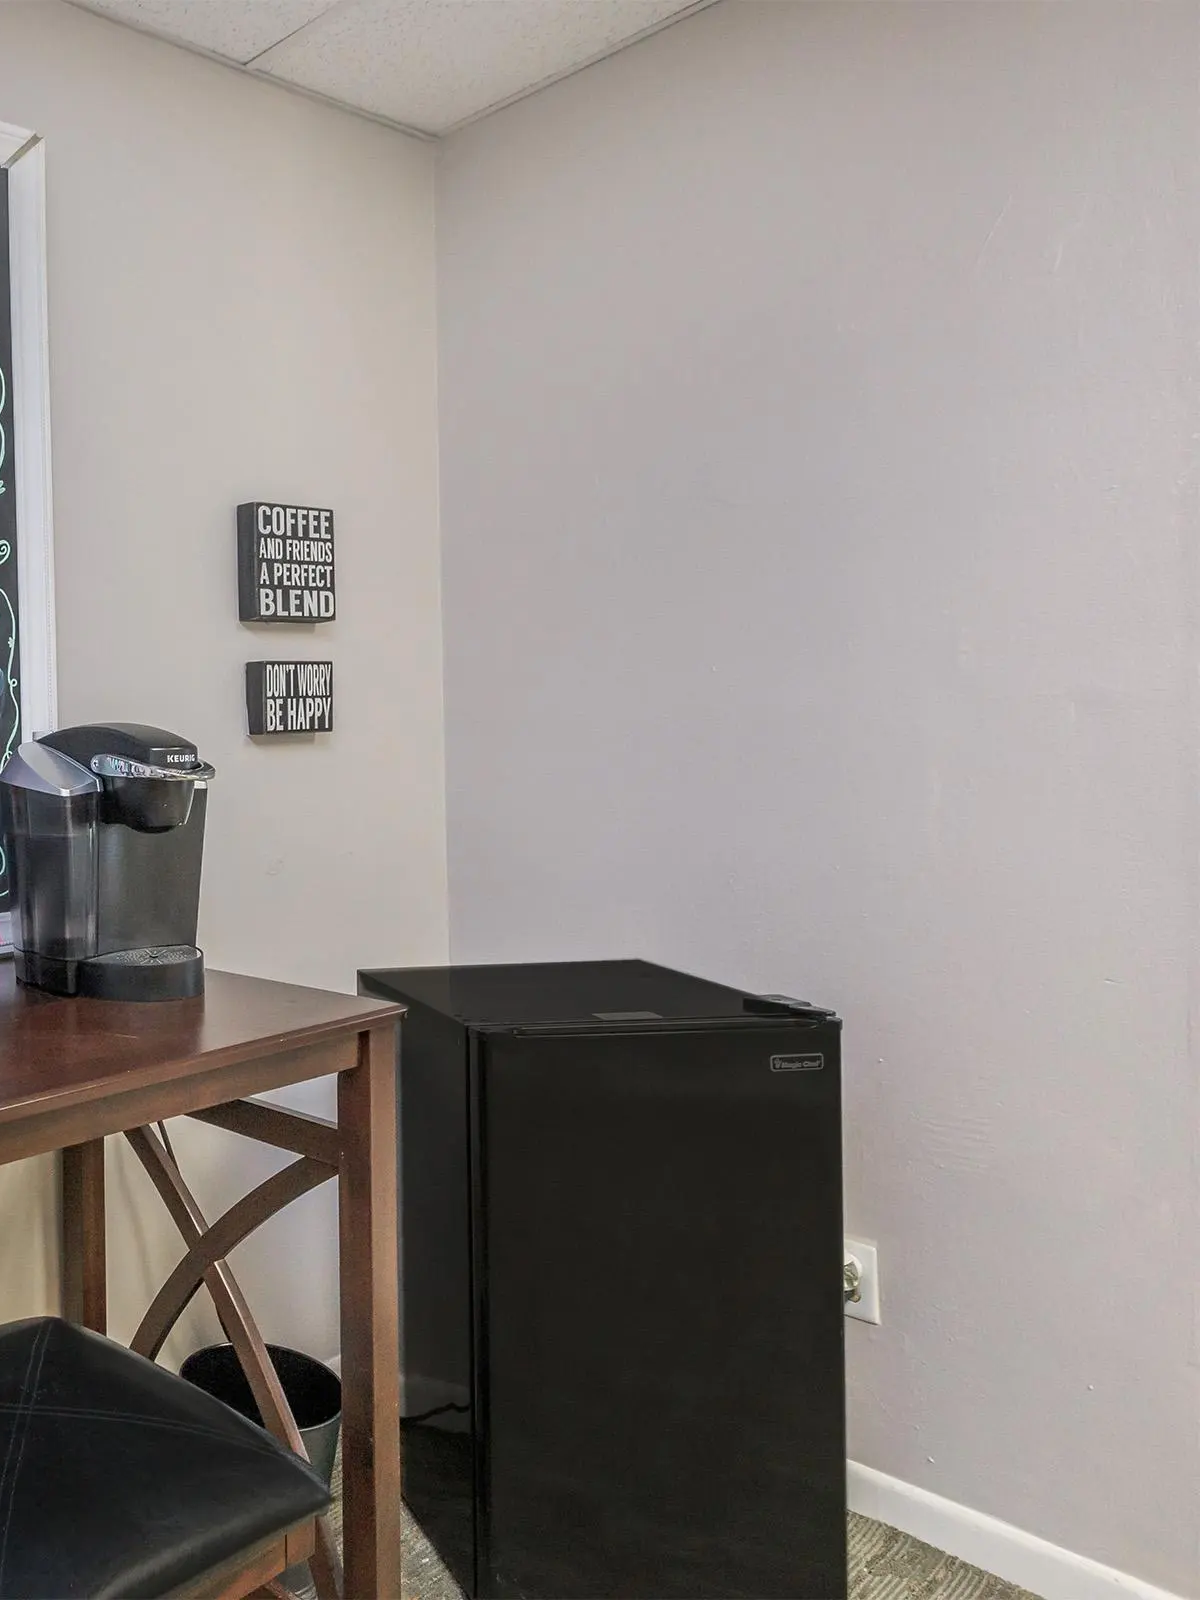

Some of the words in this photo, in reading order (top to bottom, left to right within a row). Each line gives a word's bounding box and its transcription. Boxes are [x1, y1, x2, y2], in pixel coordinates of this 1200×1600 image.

[258, 505, 332, 539] COFFEE
[259, 537, 283, 560] AND
[286, 539, 333, 563] FRIENDS
[260, 561, 270, 585] A
[273, 562, 333, 588] PERFECT
[260, 588, 335, 618] BLEND
[266, 664, 295, 697] DON'T
[297, 663, 331, 697] WORRY
[266, 698, 284, 731] BE
[287, 697, 331, 730] HAPPY
[167, 754, 195, 763] KEURIG
